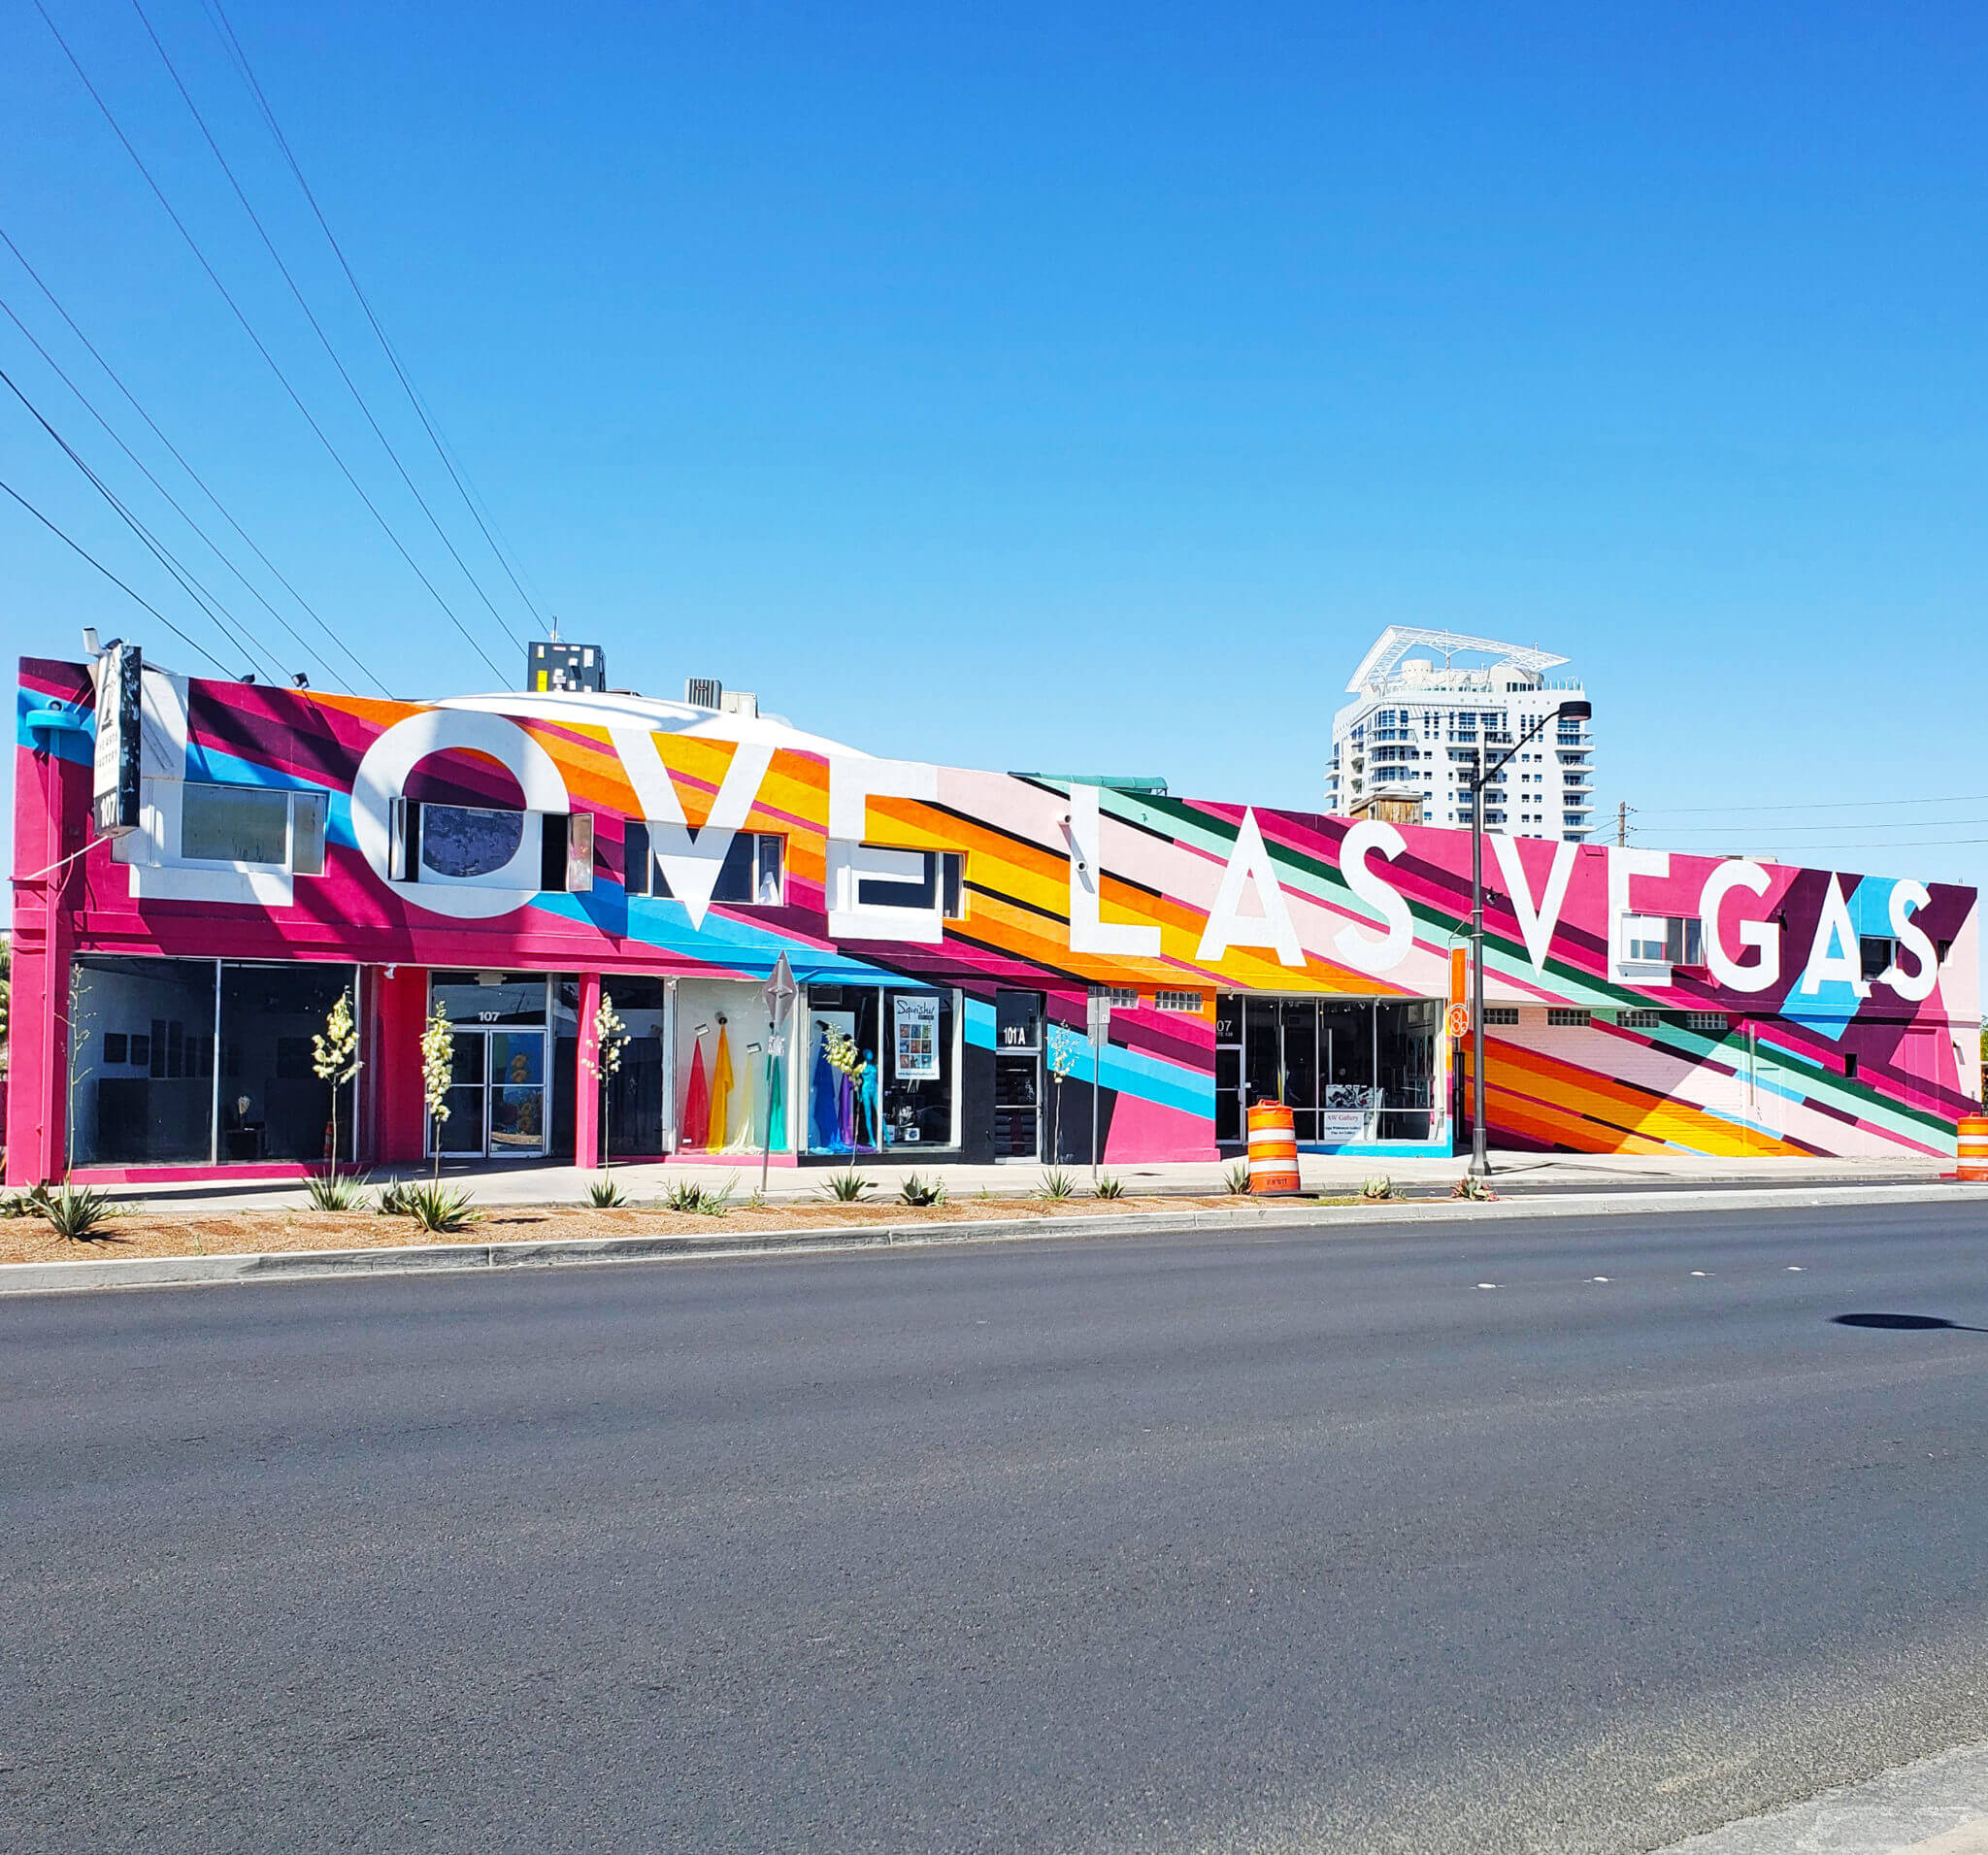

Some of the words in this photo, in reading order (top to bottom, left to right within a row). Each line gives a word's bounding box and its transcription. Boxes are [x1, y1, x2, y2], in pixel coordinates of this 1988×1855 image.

[100, 792, 117, 828] 107
[129, 670, 944, 944] LOVE
[1070, 782, 1414, 972] LAS
[1490, 833, 1938, 1003] VEGAS
[478, 1011, 501, 1022] 107
[1216, 1020, 1232, 1032] 07
